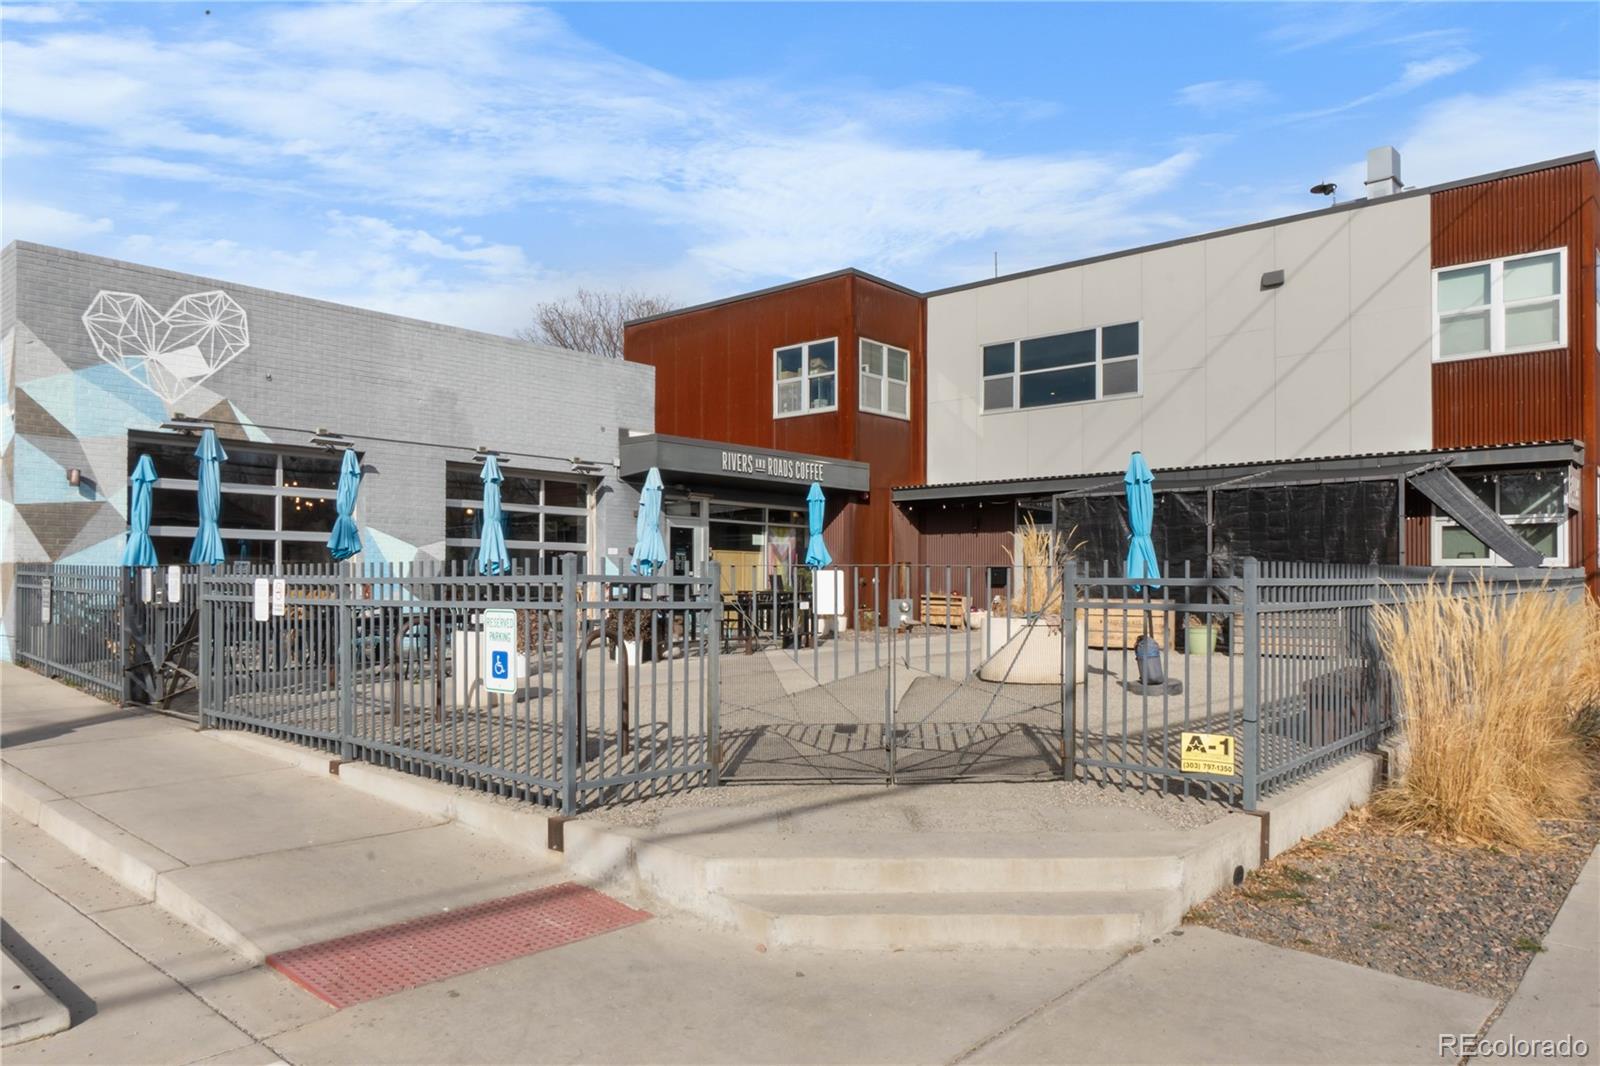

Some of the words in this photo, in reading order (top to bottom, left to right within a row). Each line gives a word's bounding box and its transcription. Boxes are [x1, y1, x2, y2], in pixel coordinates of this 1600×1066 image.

[722, 451, 753, 473] RIVERS
[768, 457, 793, 478] ROADS
[795, 461, 824, 481] COFFEE
[486, 617, 514, 629] RESERVED
[489, 631, 512, 642] PARKING
[1186, 735, 1230, 756] A-1
[1183, 762, 1201, 770] (303)
